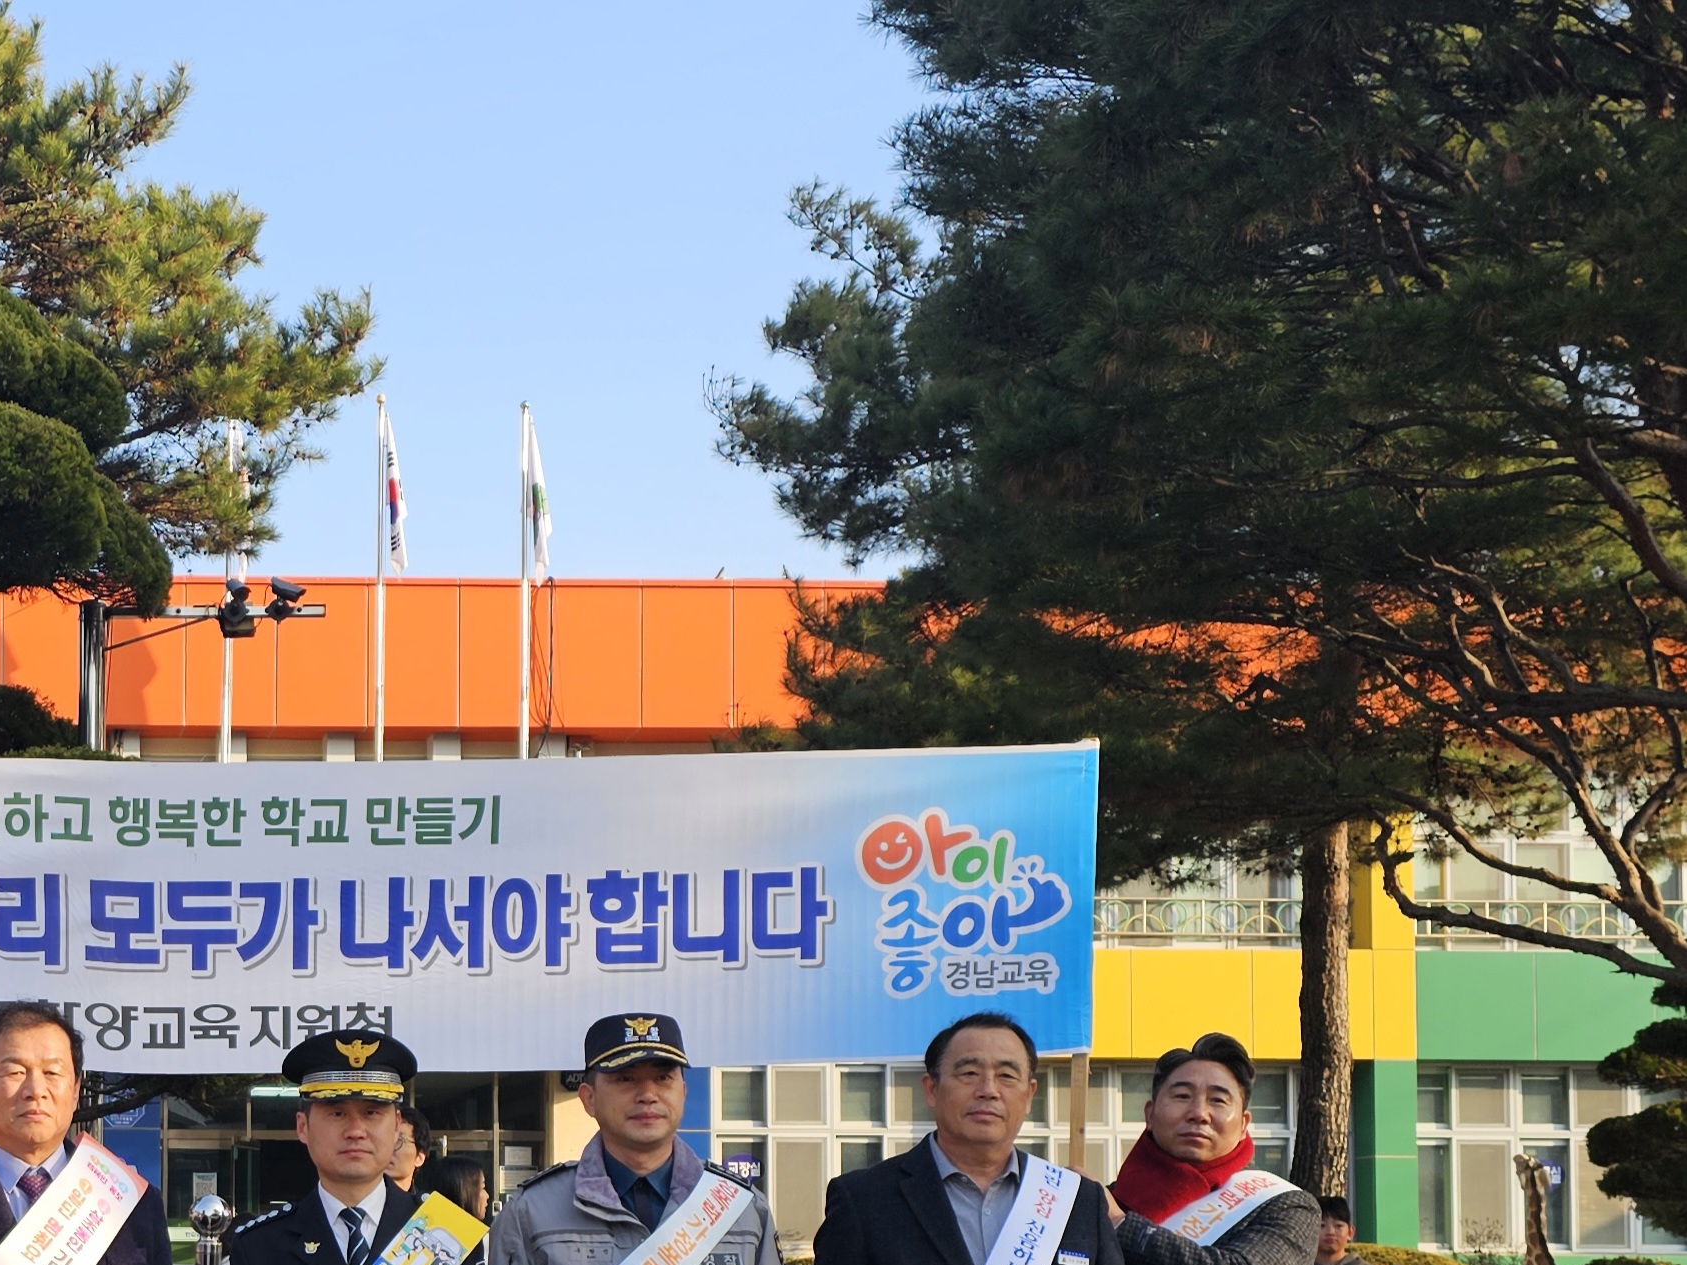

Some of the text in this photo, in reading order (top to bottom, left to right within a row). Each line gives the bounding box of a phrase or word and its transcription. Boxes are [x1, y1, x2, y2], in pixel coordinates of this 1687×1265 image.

[108, 795, 244, 847] 행복한
[261, 795, 349, 846] 학교
[365, 794, 502, 846] 만들기
[84, 877, 317, 971] 모두가
[339, 872, 571, 970] 나서야
[586, 866, 828, 964] 합니다
[882, 876, 1065, 993] 좋아
[946, 958, 1053, 989] 경남교육
[728, 1161, 761, 1178] 교장실
